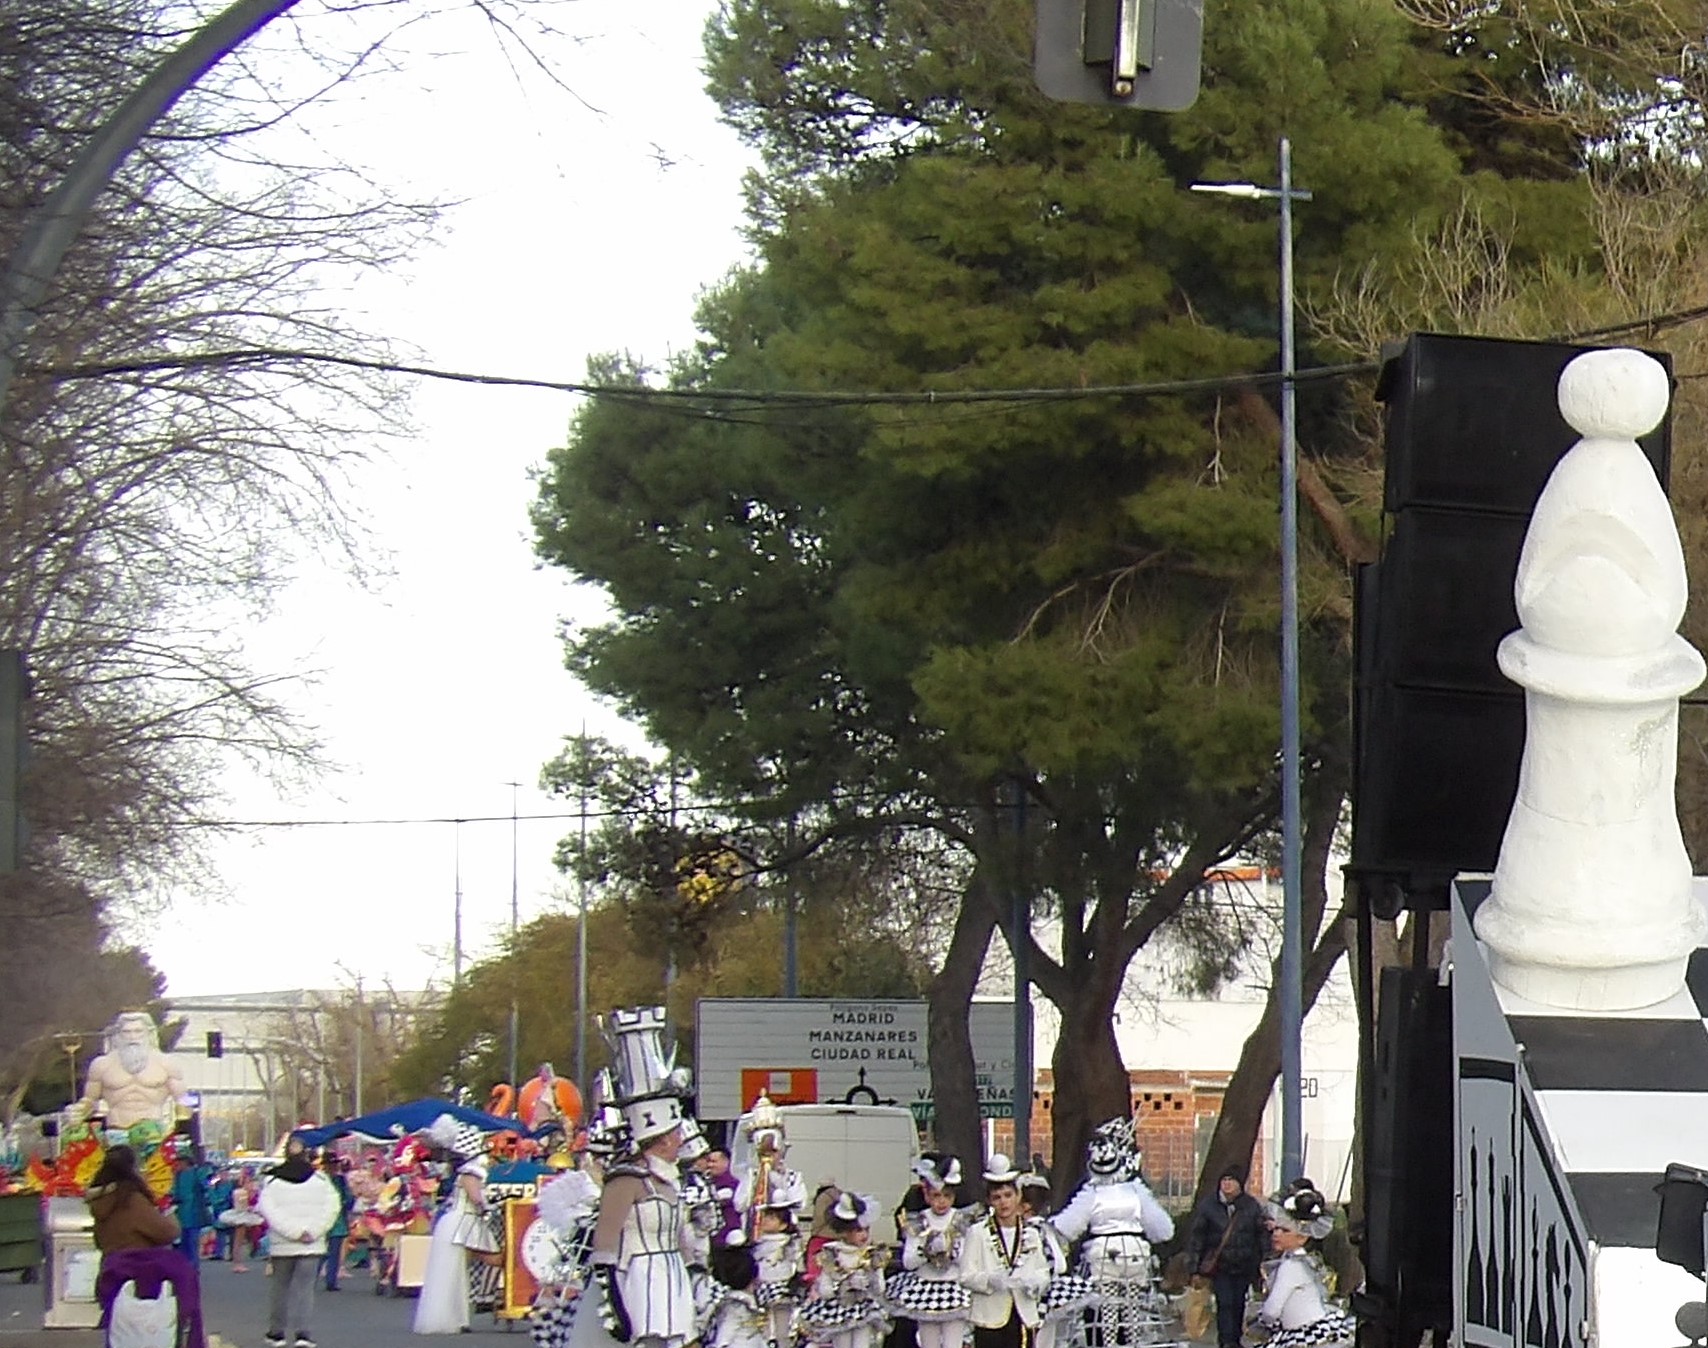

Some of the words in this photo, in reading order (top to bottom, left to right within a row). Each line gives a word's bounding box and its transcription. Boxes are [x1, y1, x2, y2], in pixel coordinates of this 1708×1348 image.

[833, 1013, 895, 1024] MADRID
[809, 1030, 918, 1042] MANZANARES
[811, 1048, 871, 1060] CIUDAD
[877, 1048, 917, 1060] REAL
